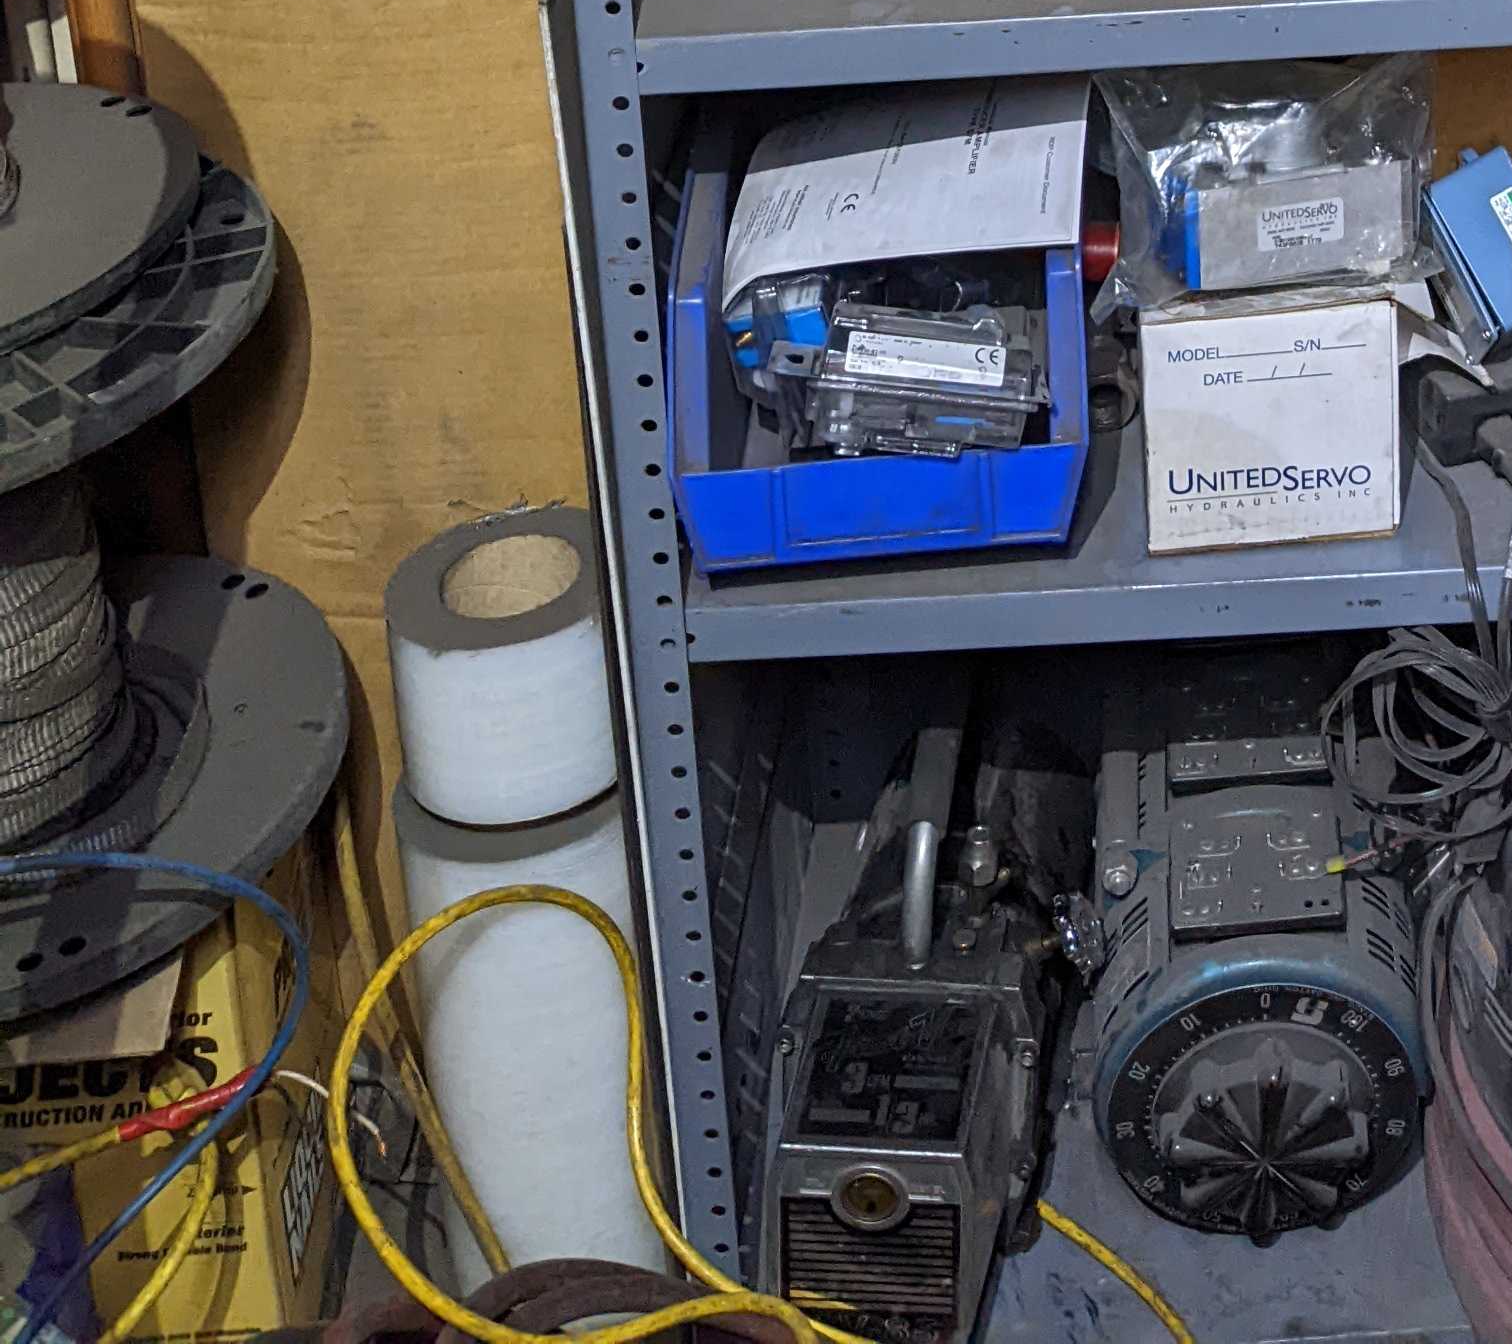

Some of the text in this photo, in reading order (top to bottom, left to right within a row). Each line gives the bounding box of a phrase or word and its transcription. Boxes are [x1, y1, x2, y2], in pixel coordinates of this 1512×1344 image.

[840, 193, 859, 214] CE
[975, 347, 999, 365] CE
[1168, 339, 1321, 362] MODEL S/N
[1204, 372, 1243, 386] DATE
[1169, 464, 1371, 495] UNITEDSERVO
[1170, 488, 1371, 513] HYDRAULICS INC
